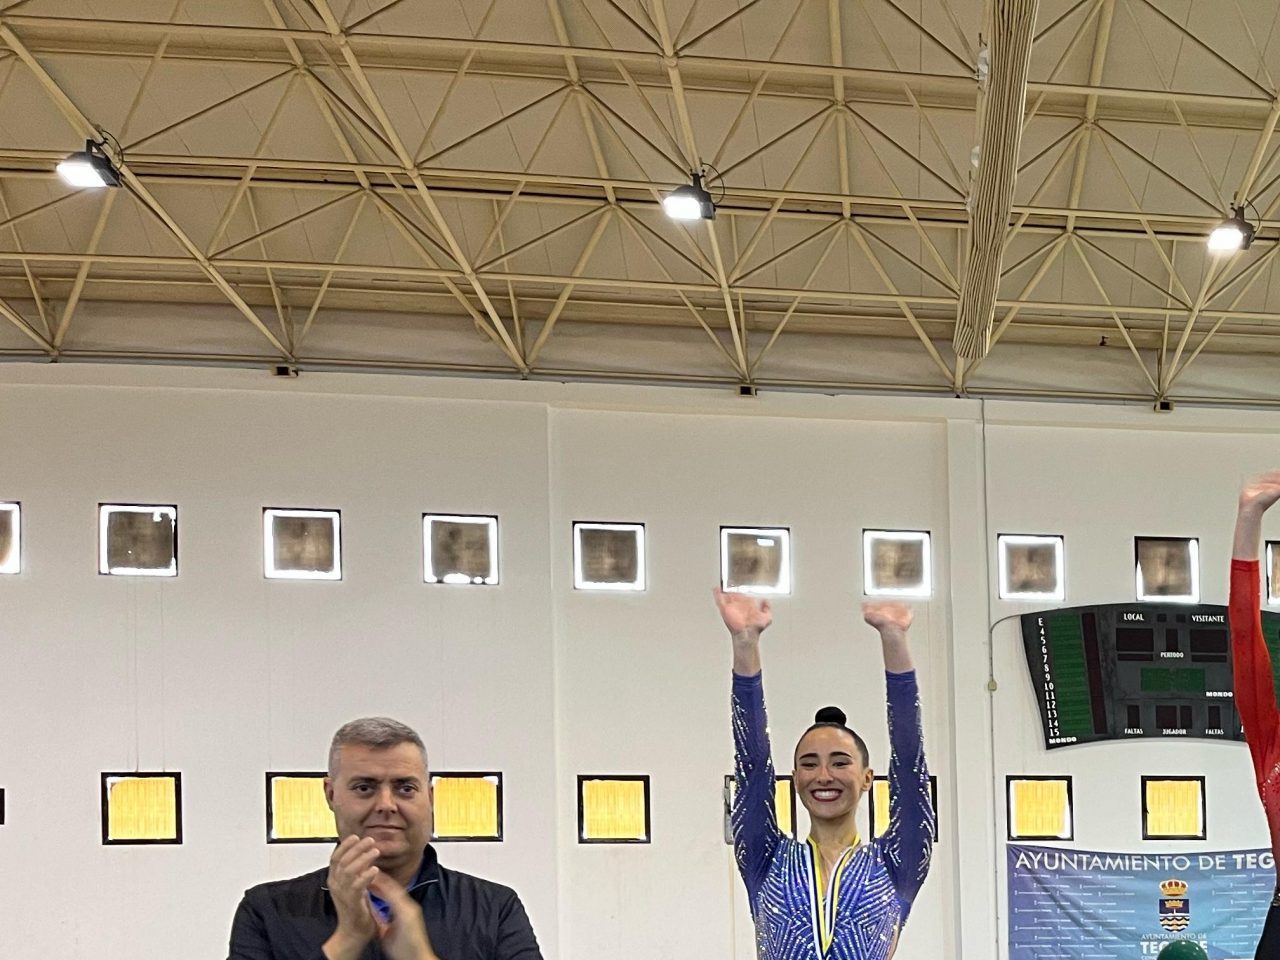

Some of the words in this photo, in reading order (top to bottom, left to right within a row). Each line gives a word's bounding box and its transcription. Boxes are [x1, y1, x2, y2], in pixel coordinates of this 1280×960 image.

[1038, 617, 1044, 626] E
[1123, 613, 1145, 621] LOCAL
[1191, 614, 1225, 623] VISITANTE
[1049, 736, 1077, 744] MONDO
[1014, 852, 1191, 871] AYUNTAMIENTO
[1199, 855, 1226, 870] DE
